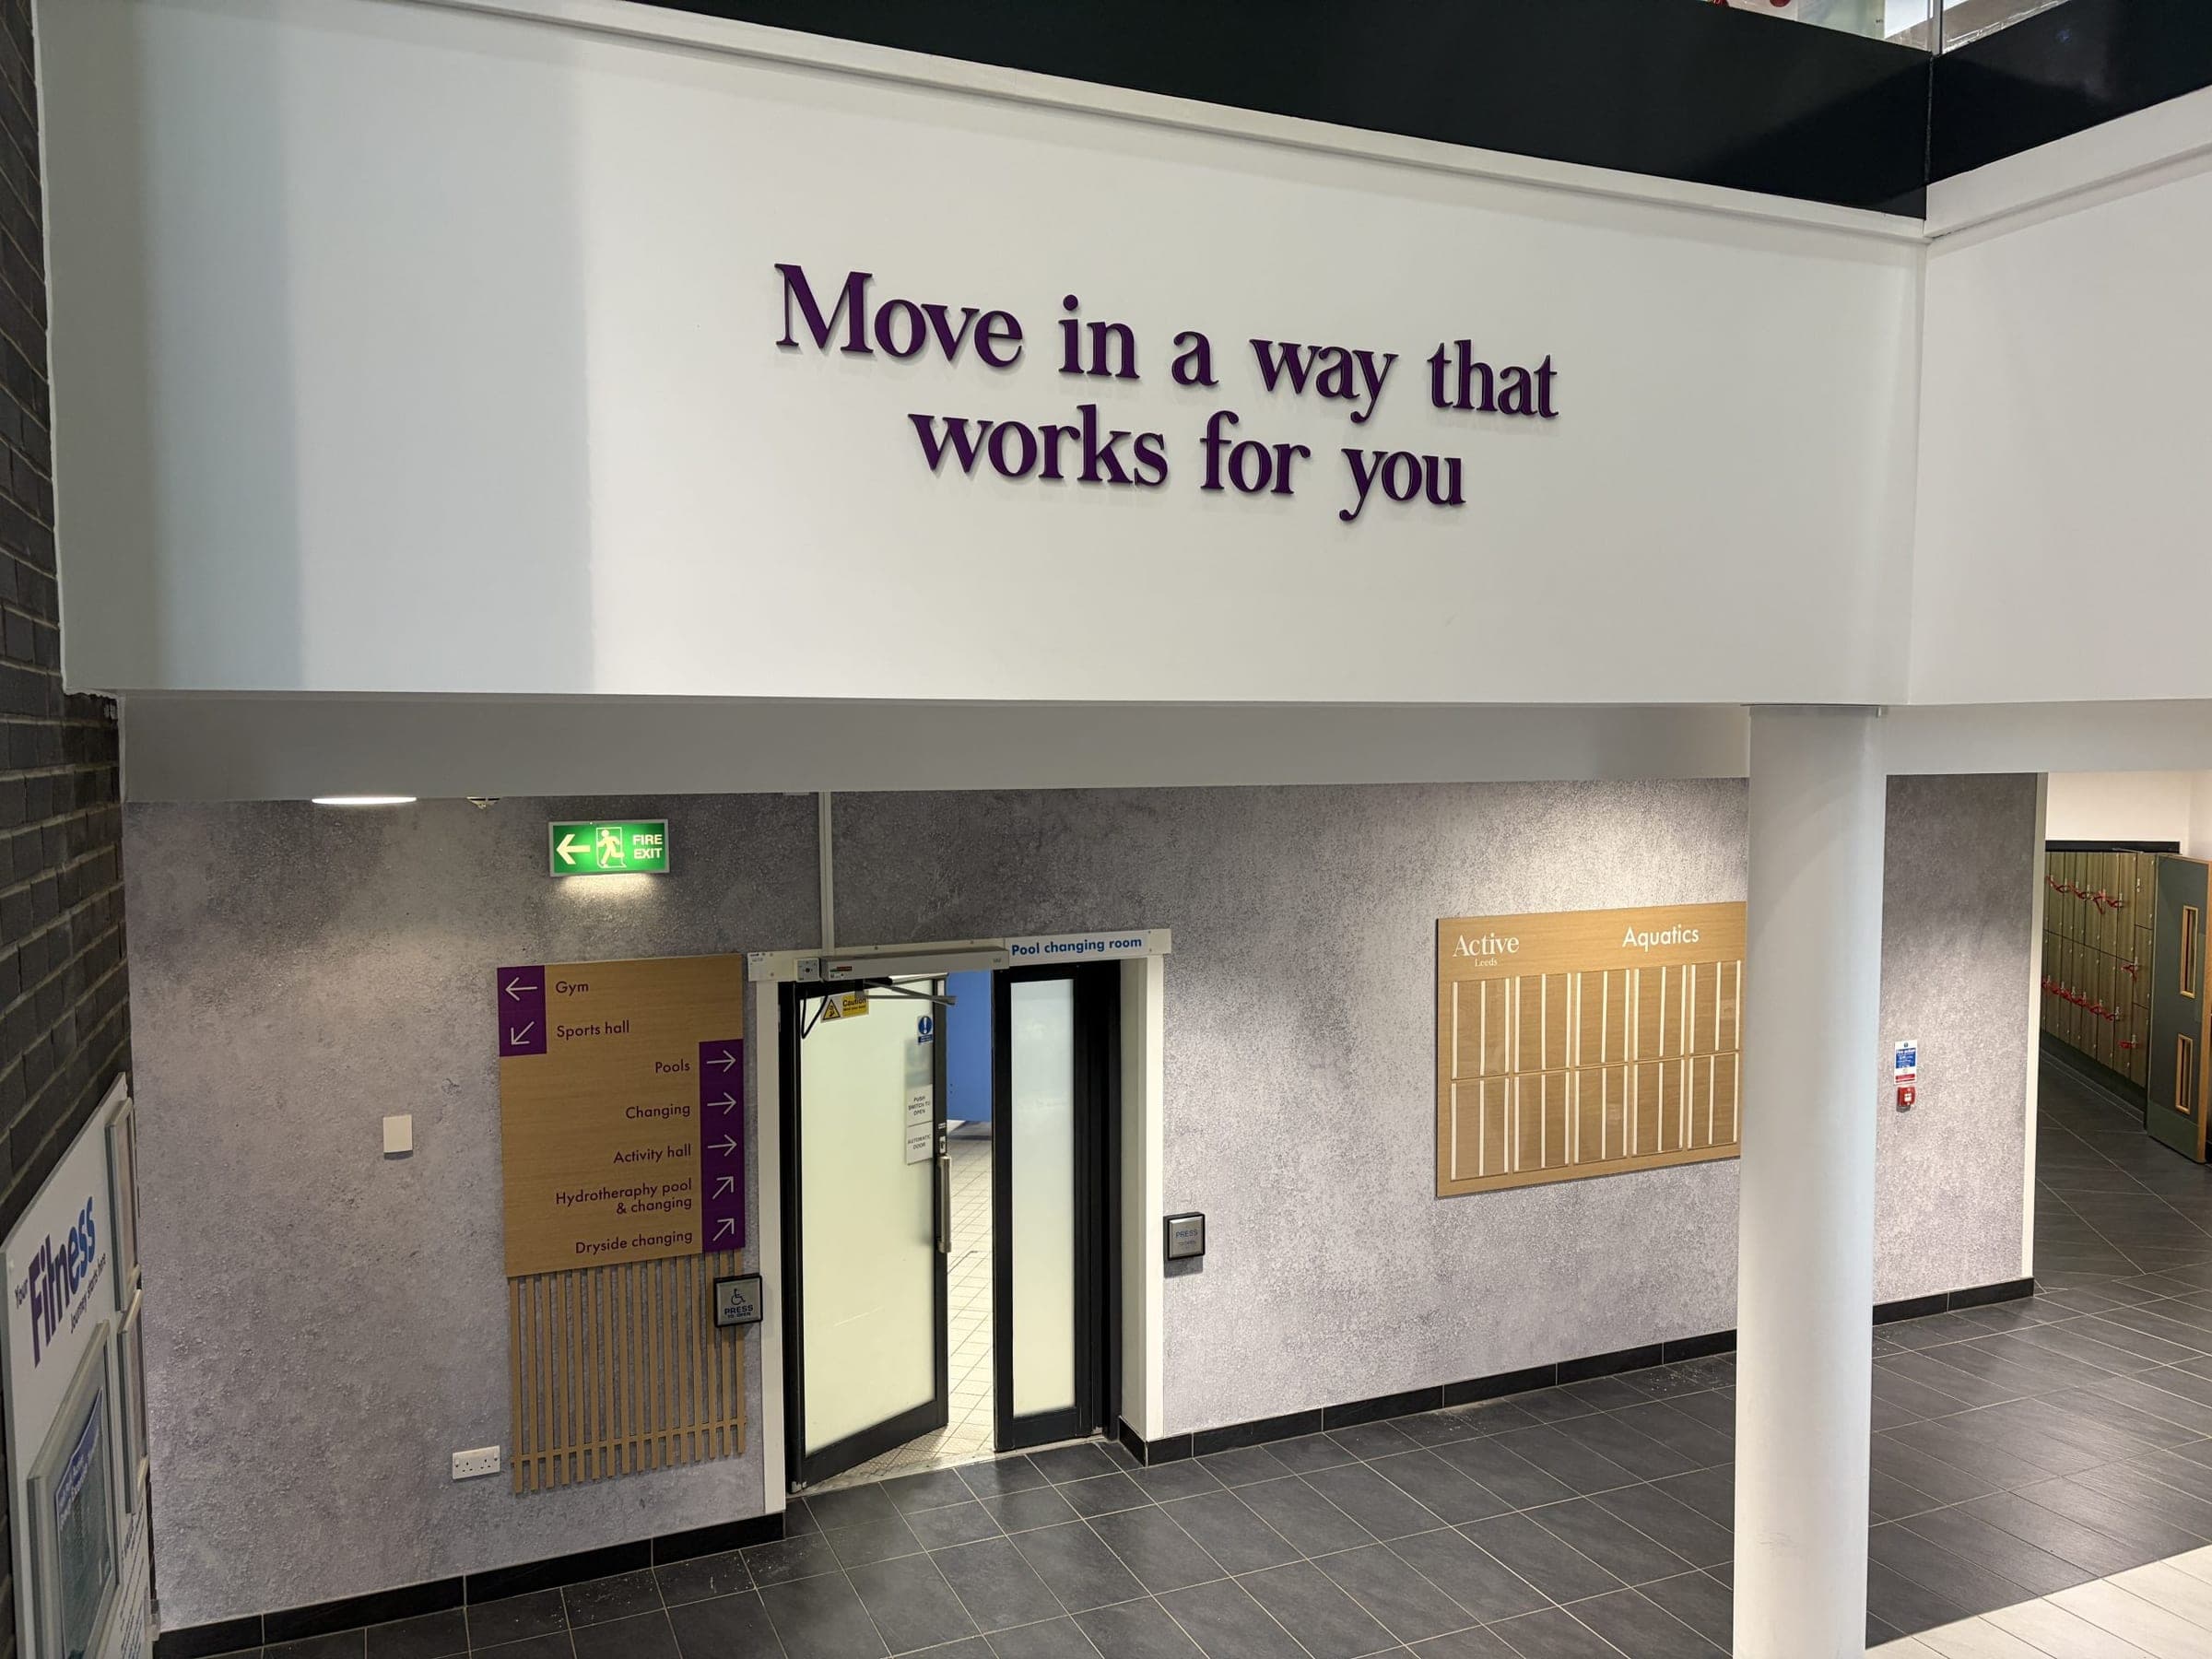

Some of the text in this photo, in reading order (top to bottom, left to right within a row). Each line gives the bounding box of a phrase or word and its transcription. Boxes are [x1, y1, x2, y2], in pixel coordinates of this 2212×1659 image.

[774, 263, 1559, 424] Move in a way that
[908, 404, 1466, 523] works for you
[632, 834, 663, 845] FIRE
[633, 848, 663, 859] EXIT
[1011, 938, 1142, 956] Pool changing room
[1453, 933, 1520, 958] Active
[1621, 924, 1700, 952] Aquatics
[1475, 958, 1498, 967] Leeds
[555, 981, 589, 996] Gym
[557, 1019, 629, 1041] Sports hall
[655, 1059, 690, 1074] Pools
[626, 1103, 690, 1119] Changing
[613, 1143, 691, 1163] Activity hall
[556, 1178, 692, 1207] Hydrotheraphy pool
[616, 1196, 692, 1215] & changing
[575, 1230, 692, 1255] Dryside changing
[29, 1195, 96, 1370] Fitness
[14, 1277, 29, 1311] Your
[724, 1304, 754, 1315] PRESS
